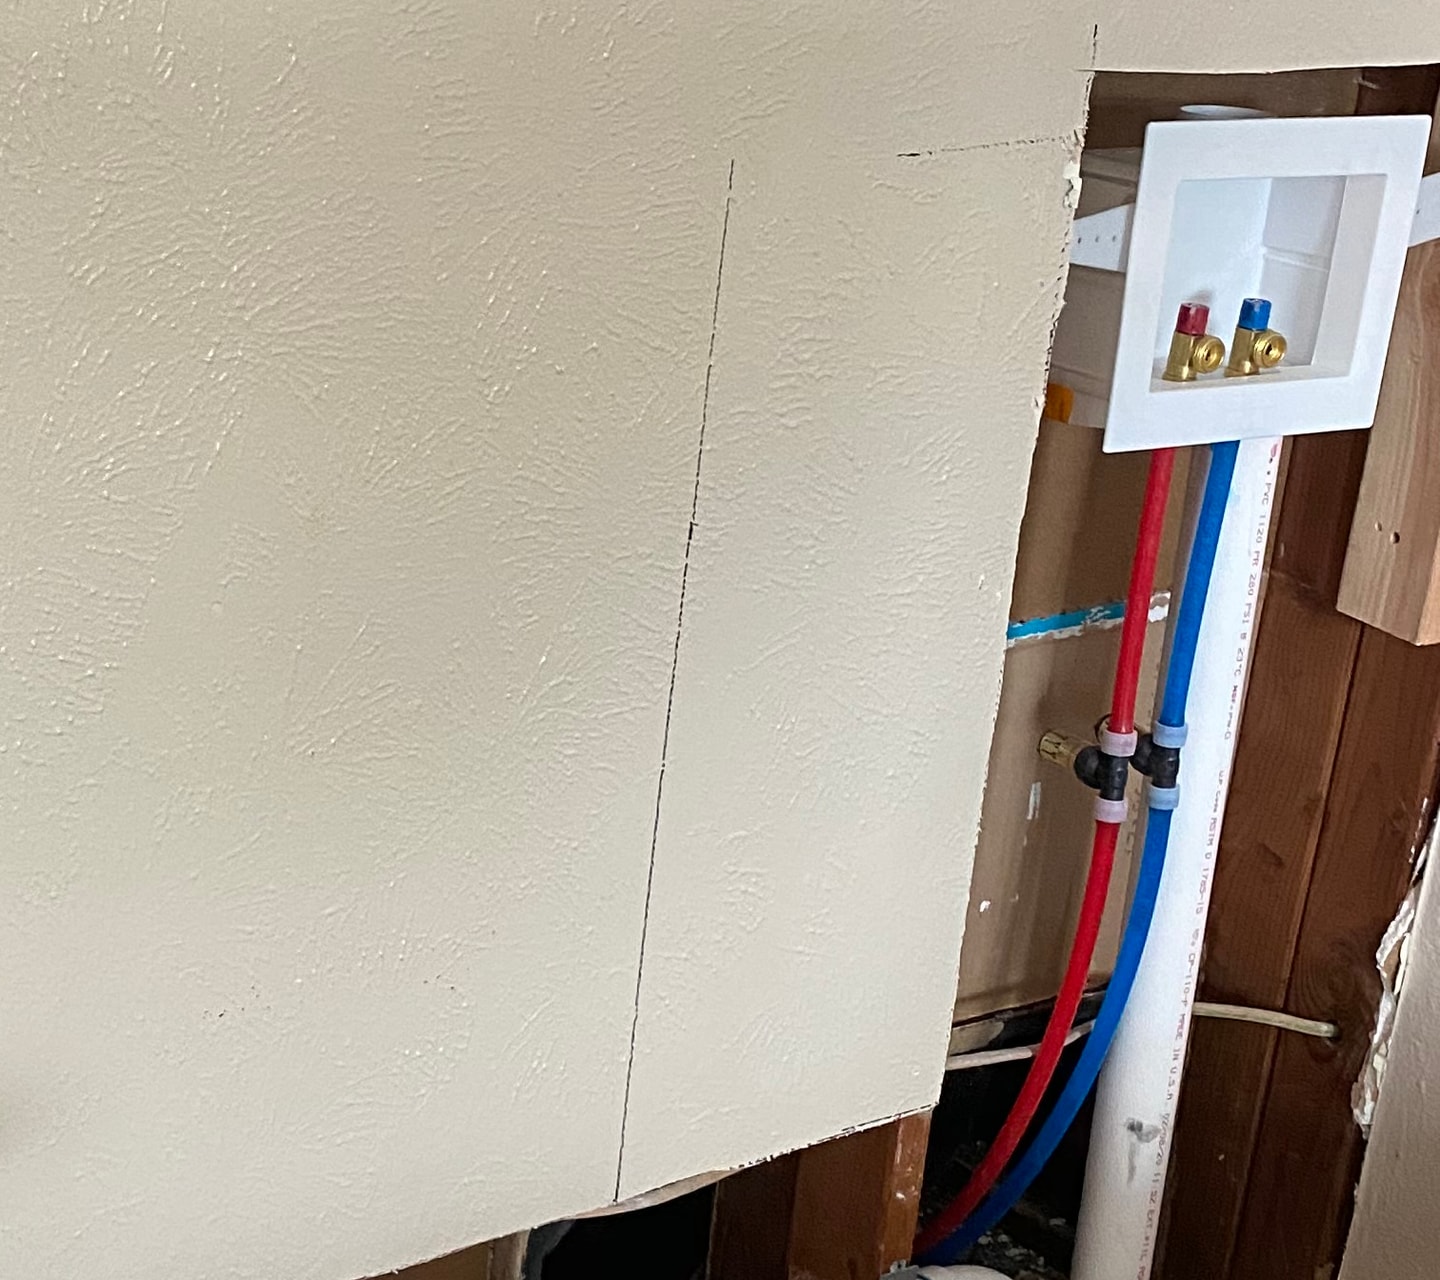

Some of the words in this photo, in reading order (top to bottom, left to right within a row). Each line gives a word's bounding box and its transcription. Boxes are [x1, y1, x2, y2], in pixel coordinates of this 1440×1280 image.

[1262, 482, 1270, 505] PVC
[1256, 514, 1265, 543] 1120
[1242, 602, 1250, 623] PSI
[1176, 1013, 1185, 1041] MADE
